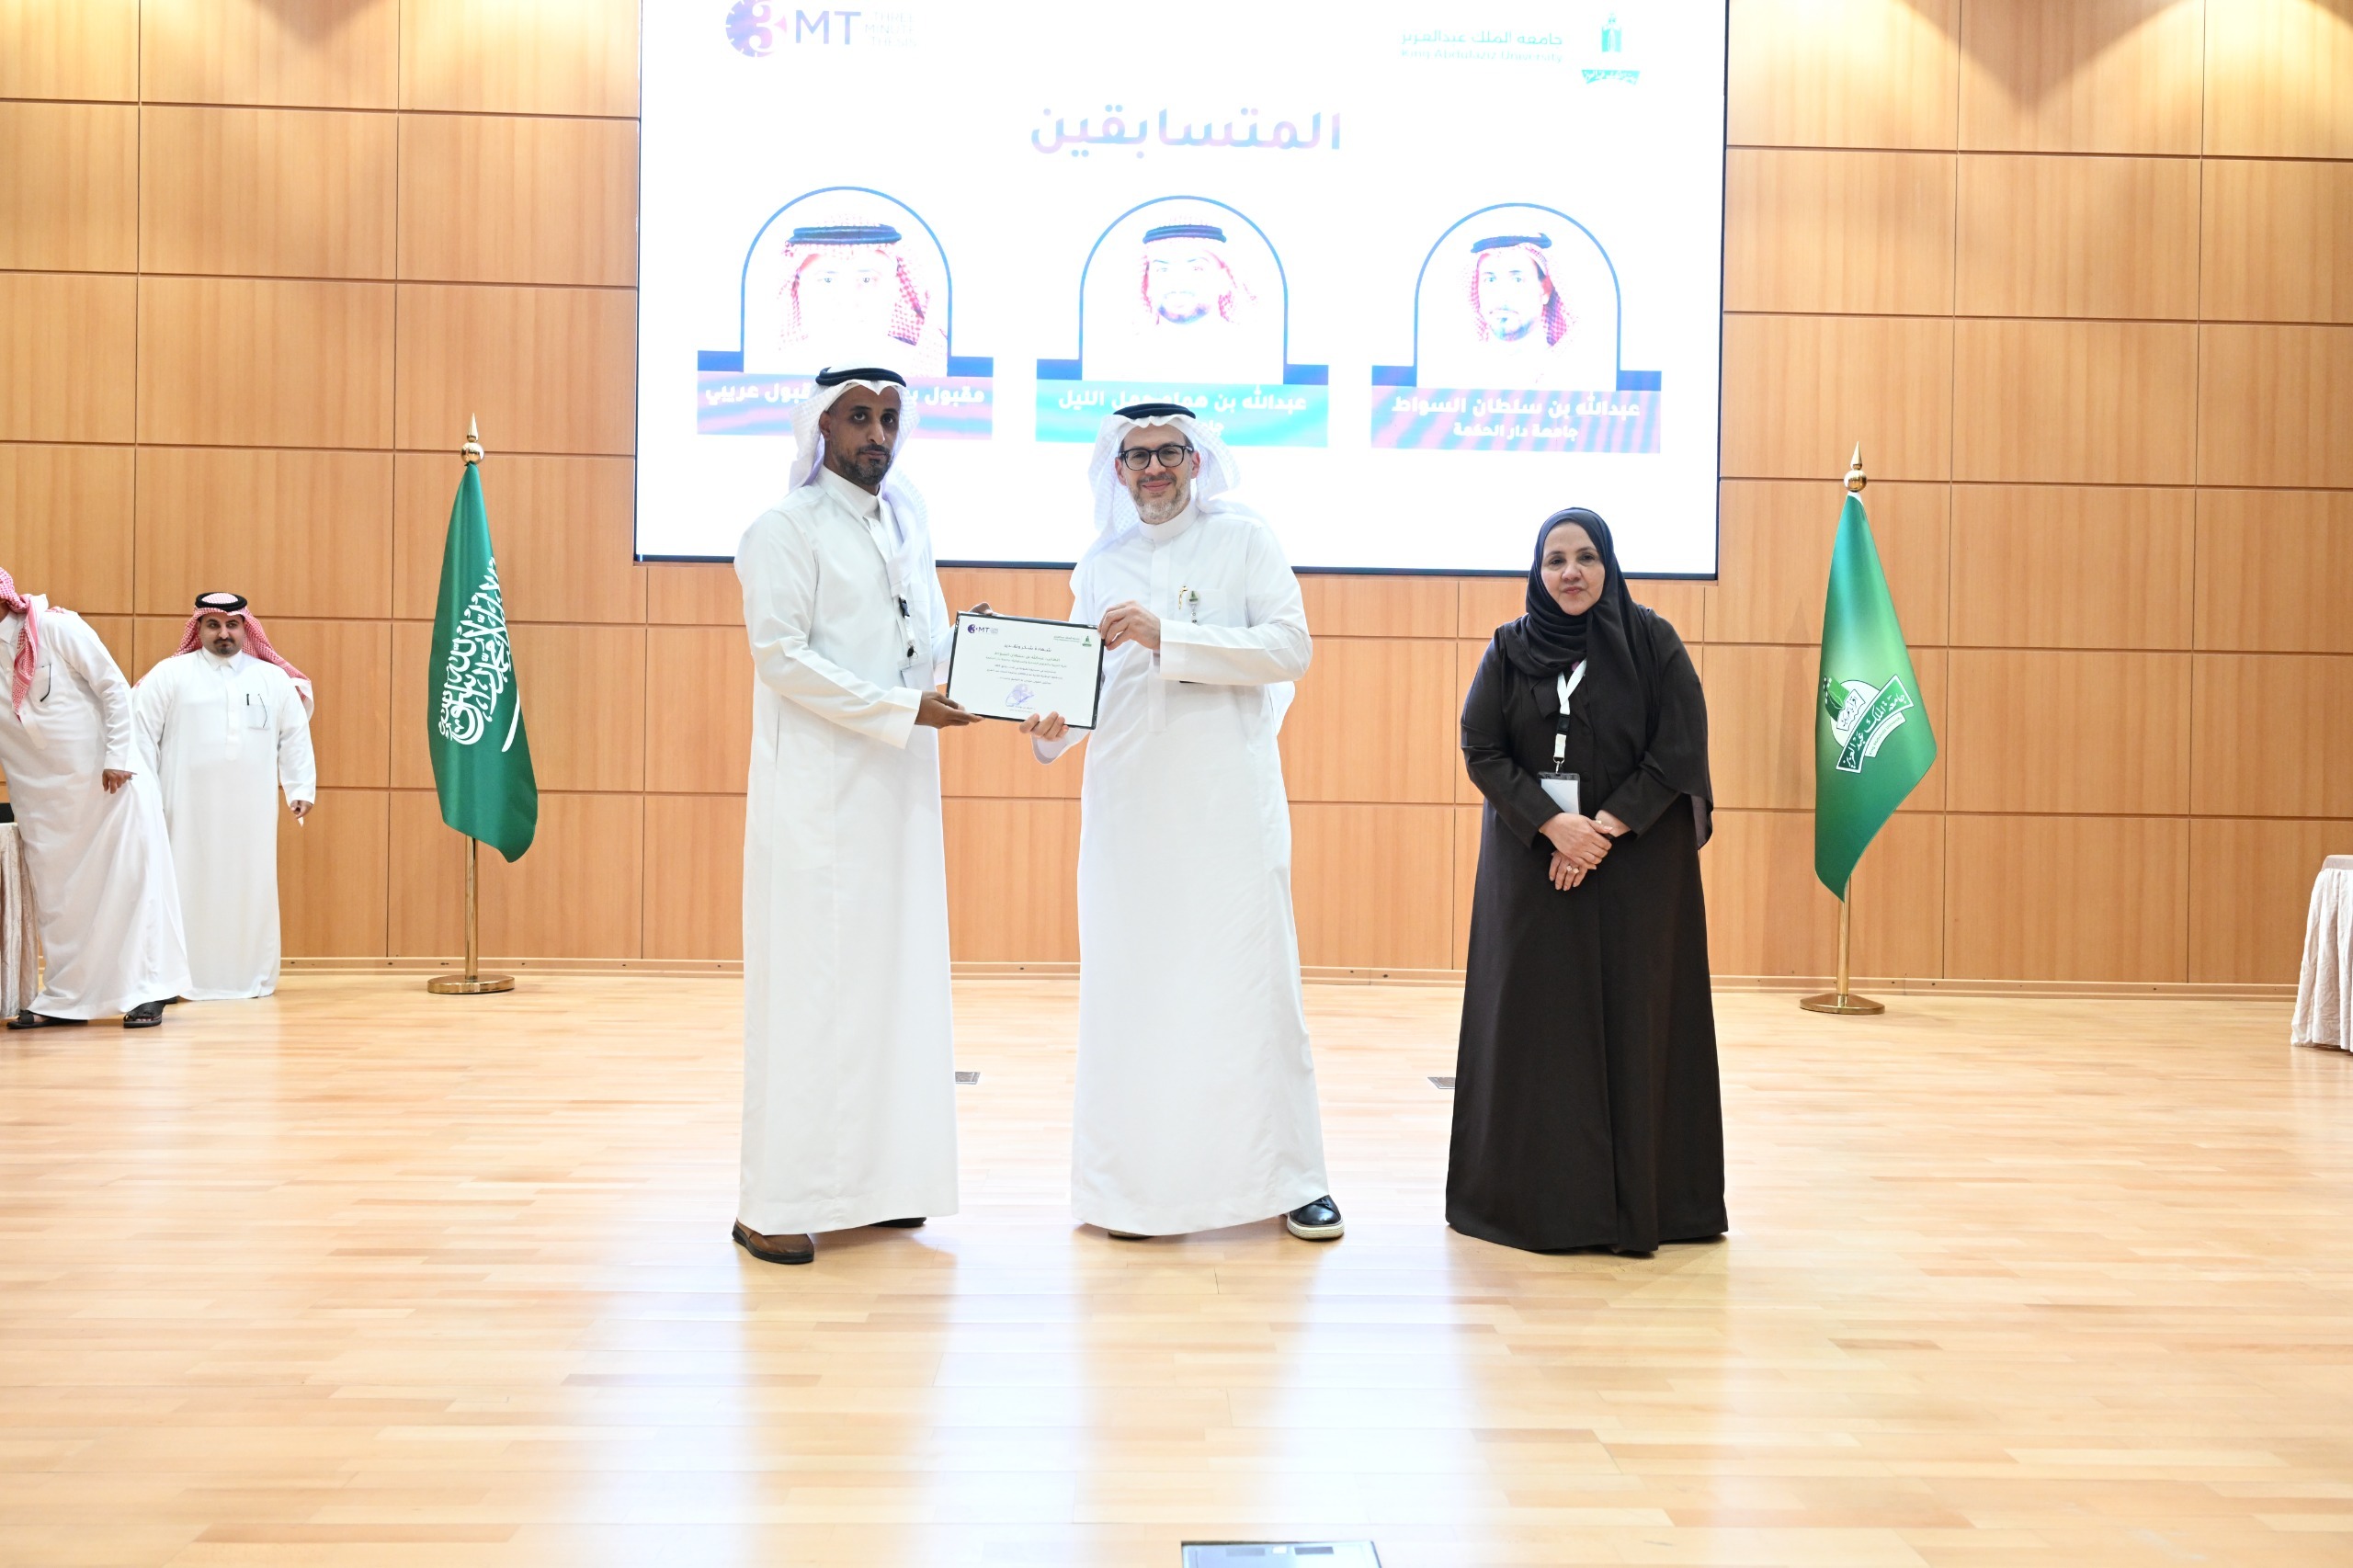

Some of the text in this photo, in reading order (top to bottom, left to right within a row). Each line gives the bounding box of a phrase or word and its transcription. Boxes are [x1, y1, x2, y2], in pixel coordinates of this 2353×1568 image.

[1030, 104, 1341, 160] المتسابقين
[764, 381, 812, 404] قبول
[925, 382, 985, 407] مقبول
[1059, 390, 1105, 411] الليل
[1213, 393, 1236, 414] بن
[1242, 384, 1307, 415] عبدالله
[1392, 391, 1641, 421] عبدالله بن سلطان السواط
[1452, 422, 1579, 442] جامعة دار الحكمة
[1864, 704, 1886, 733] الملك
